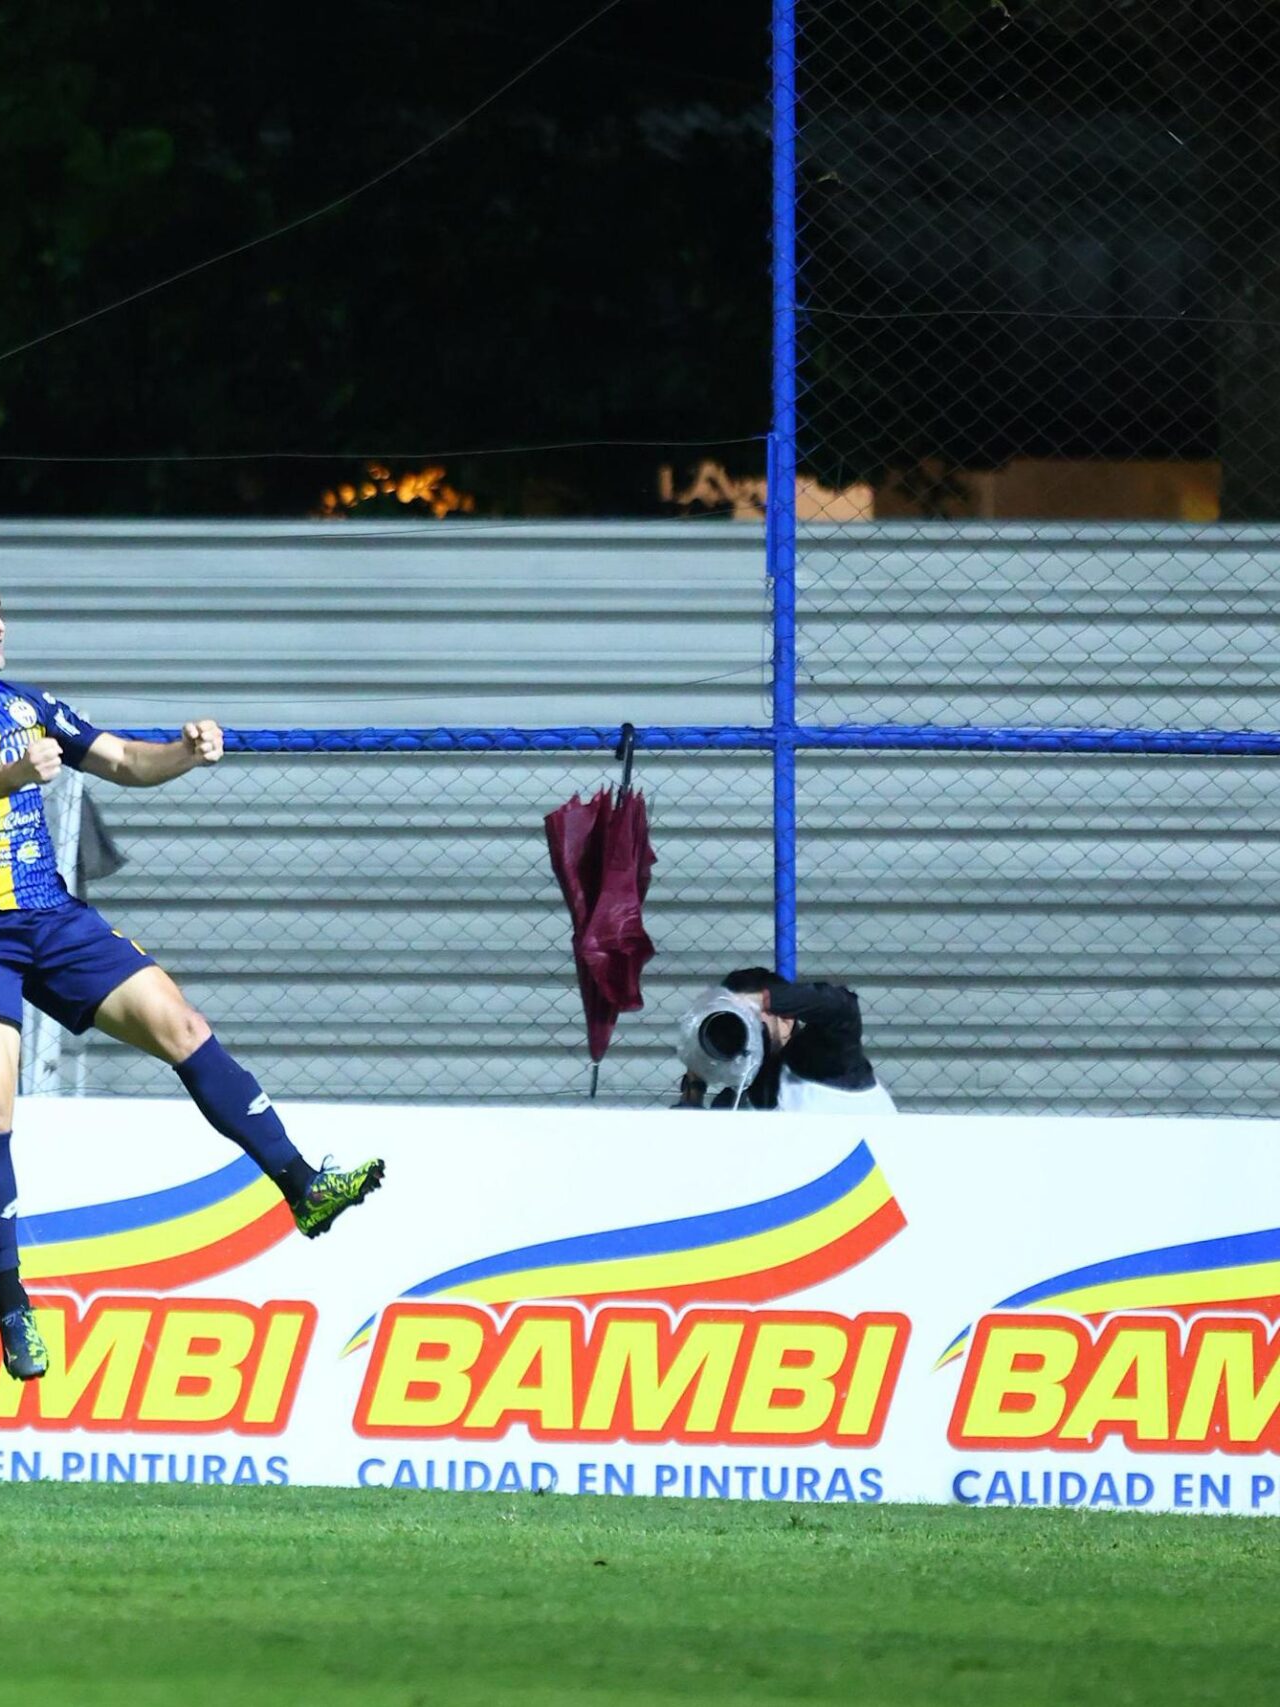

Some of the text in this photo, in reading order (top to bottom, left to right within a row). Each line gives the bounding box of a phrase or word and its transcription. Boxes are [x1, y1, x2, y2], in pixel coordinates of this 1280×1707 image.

[353, 1305, 910, 1447] BAMBI
[62, 1451, 289, 1485] PINTURAS
[357, 1458, 884, 1501] CALIDAD EN PINTURAS
[952, 1469, 1156, 1505] CALIDAD
[1174, 1473, 1232, 1508] EN
